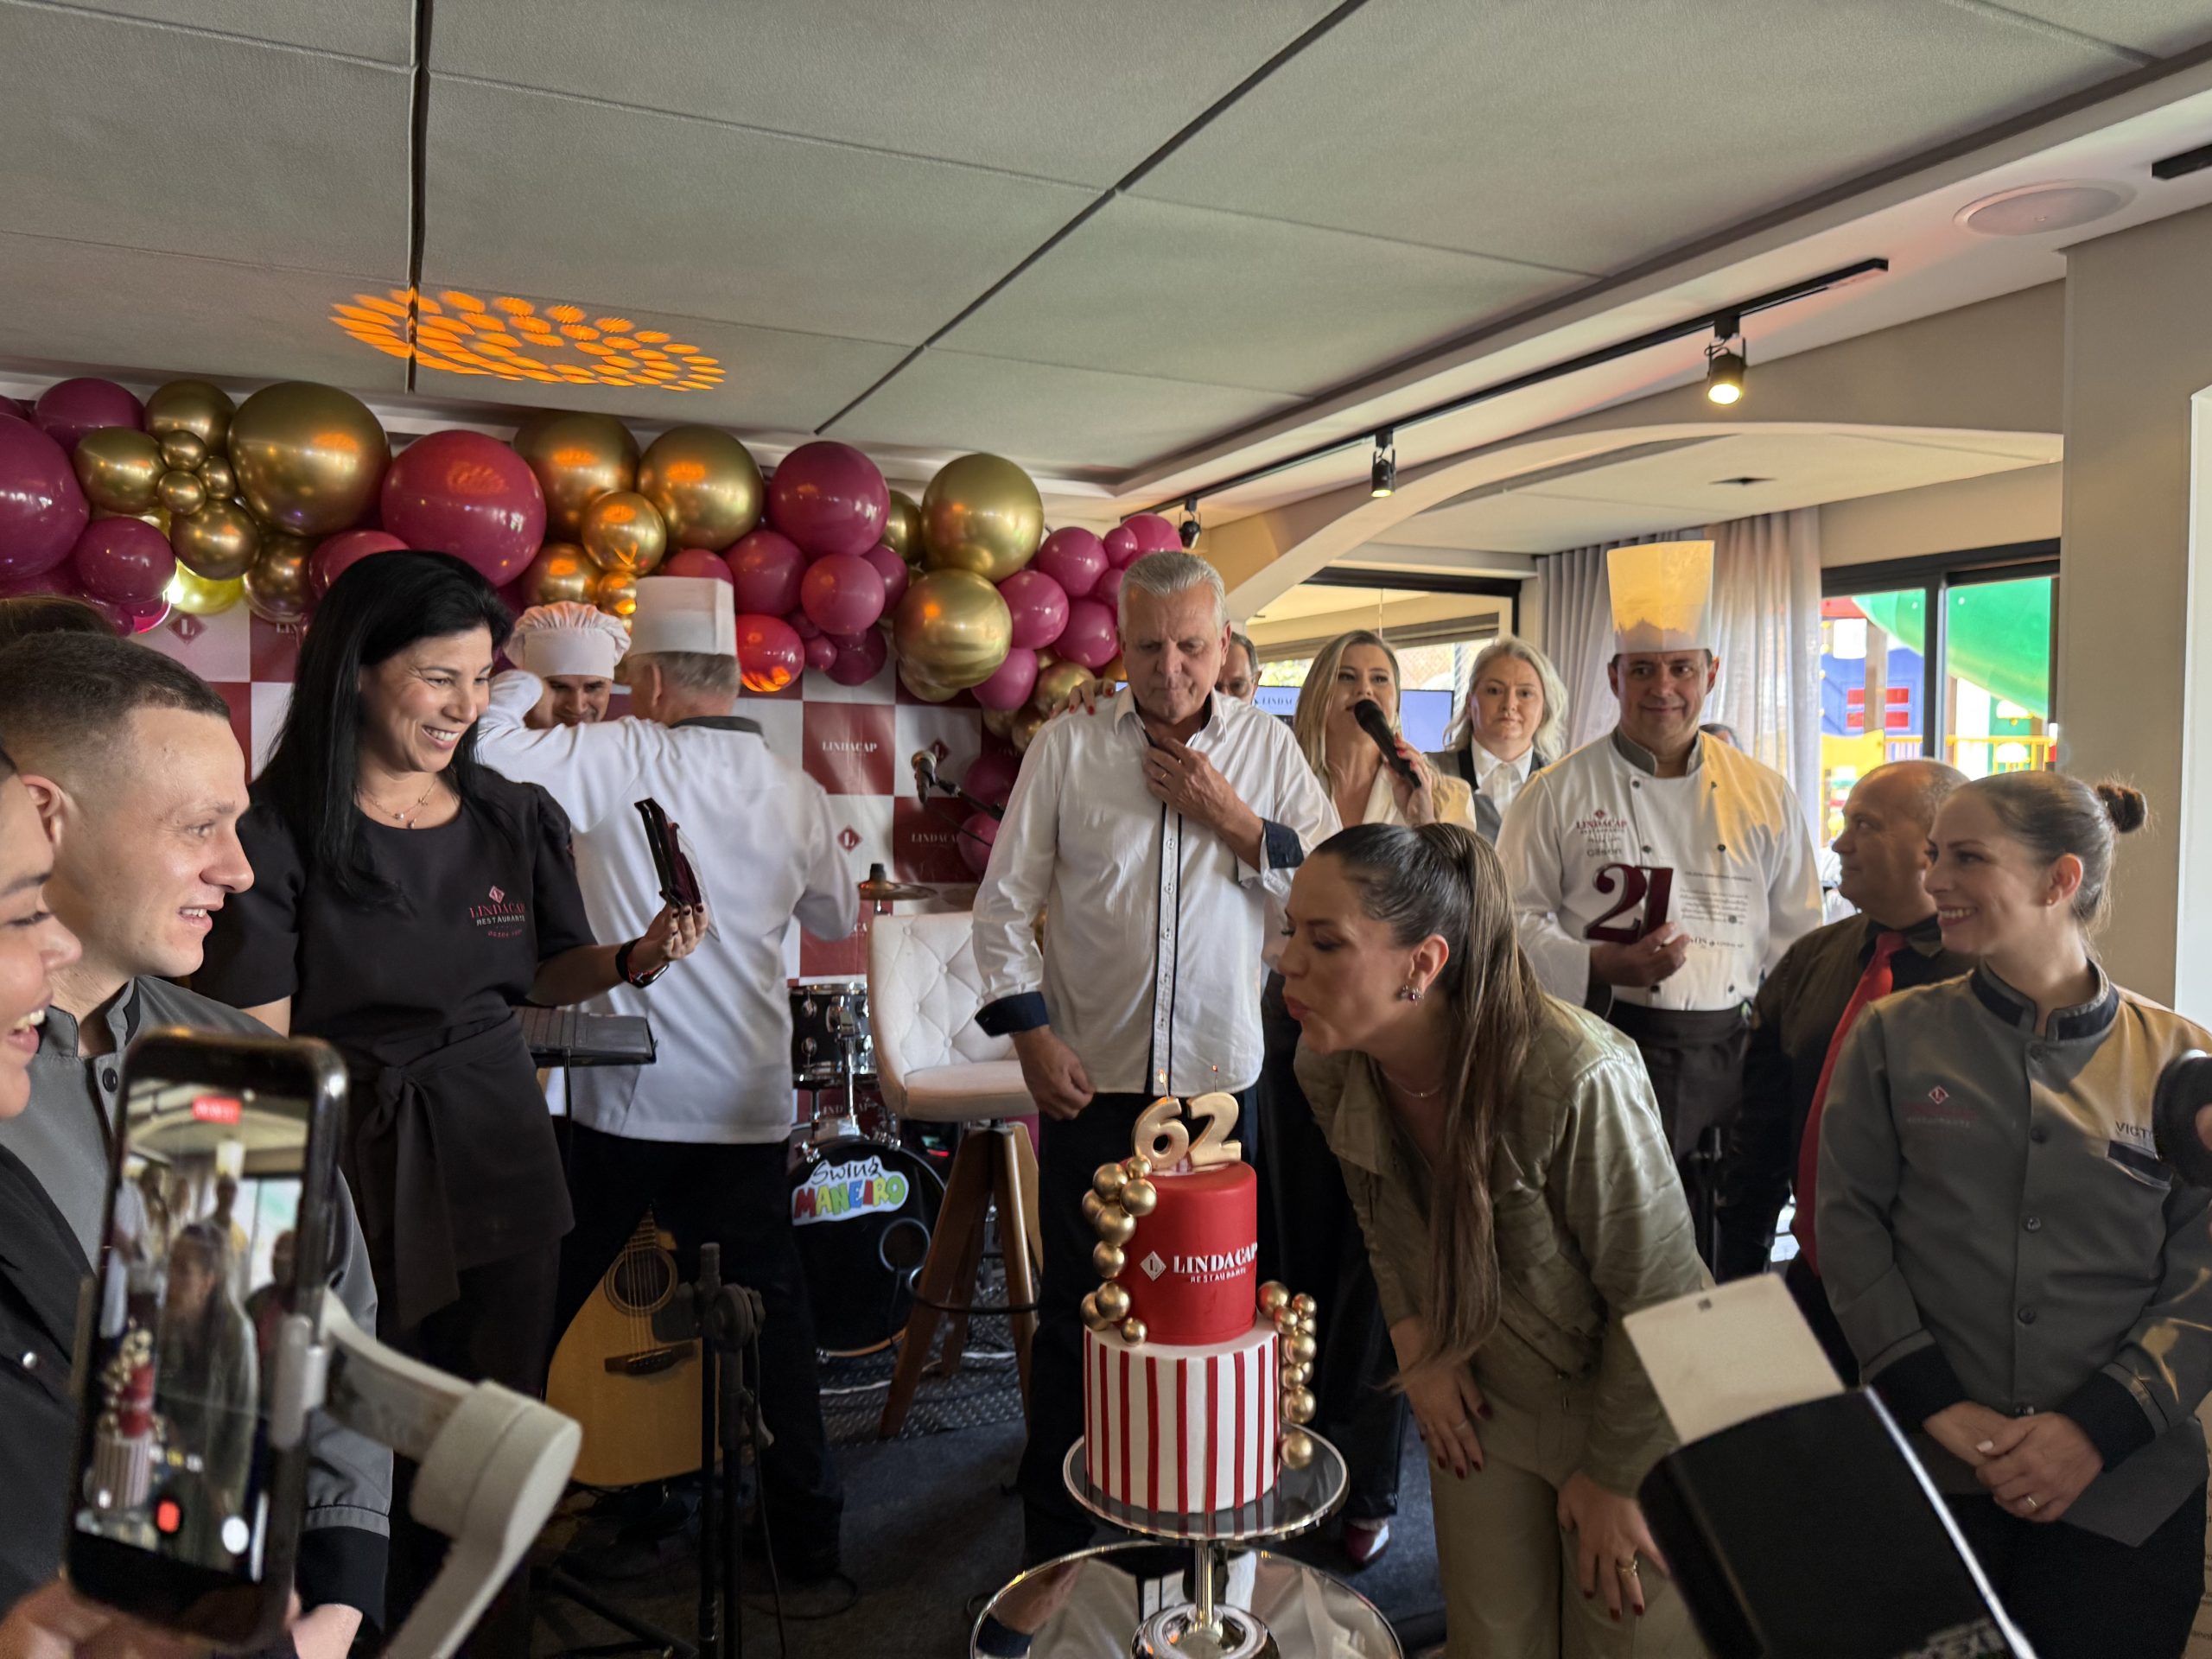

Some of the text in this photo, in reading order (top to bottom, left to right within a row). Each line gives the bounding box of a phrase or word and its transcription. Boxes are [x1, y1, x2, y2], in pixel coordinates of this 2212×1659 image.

[181, 619, 195, 636] L
[1262, 696, 1294, 706] LINDAC
[822, 741, 878, 753] LINDACAP
[843, 831, 856, 848] L
[1584, 863, 1674, 944] 21
[1131, 1092, 1242, 1174] 62
[2114, 1121, 2153, 1140] VICT
[793, 1174, 906, 1219] MANEIRO
[1173, 1242, 1259, 1274] LINDACAP
